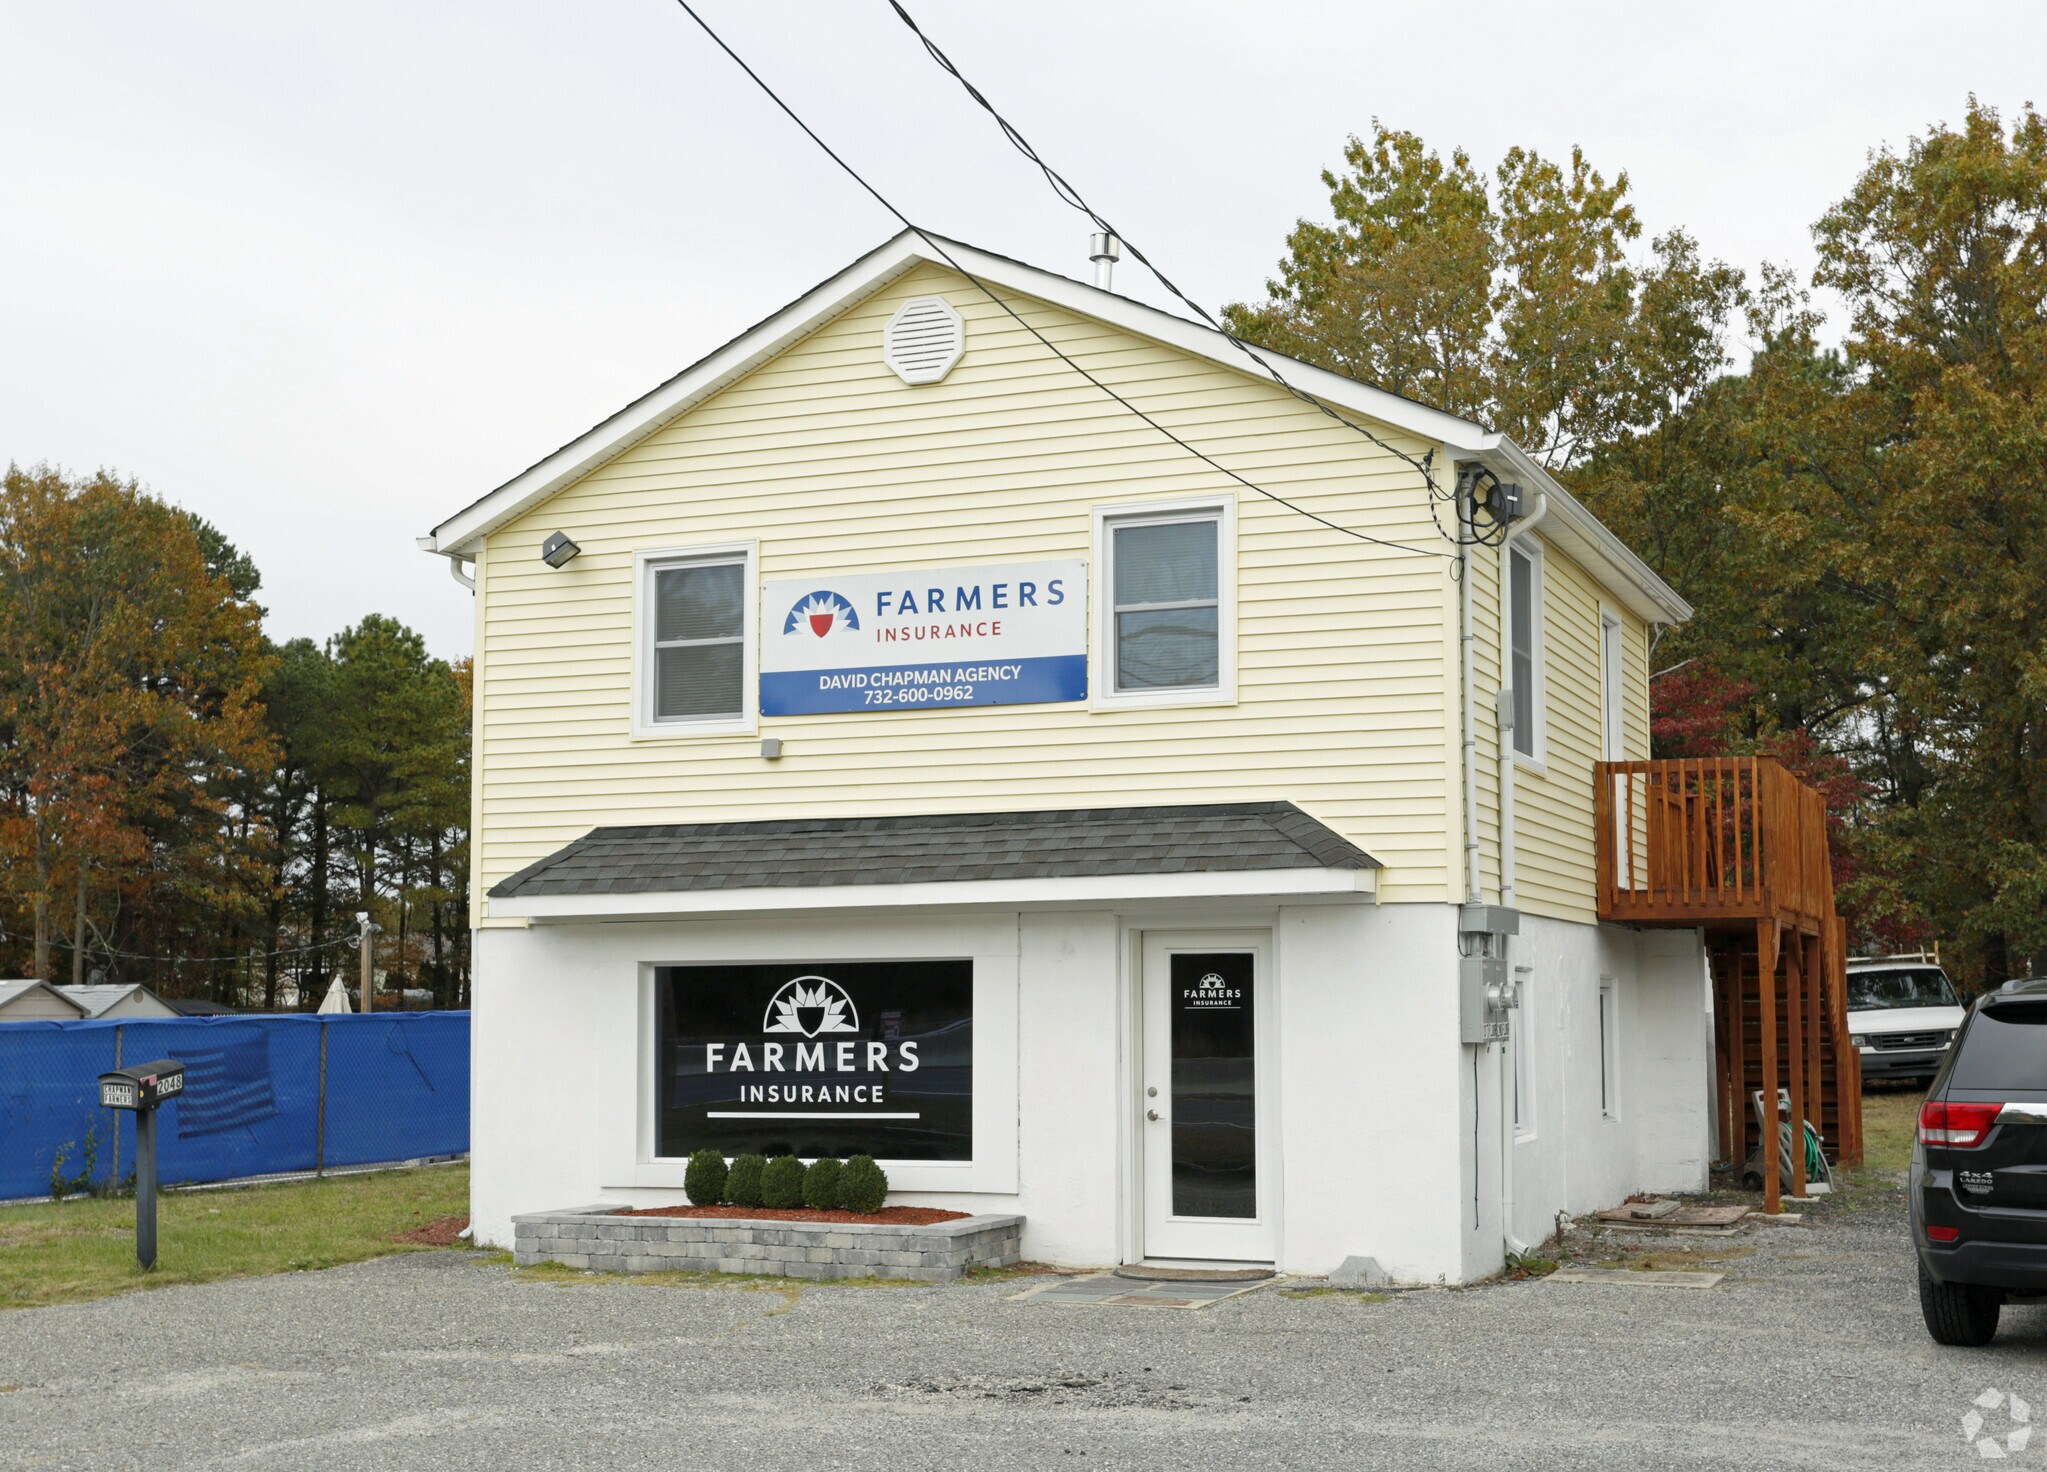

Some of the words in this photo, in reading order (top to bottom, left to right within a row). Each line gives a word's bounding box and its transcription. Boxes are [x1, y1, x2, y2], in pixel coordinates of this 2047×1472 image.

[877, 579, 1065, 617] FARMERS
[877, 621, 1002, 643] INSURANCE
[819, 674, 867, 690] DAVID
[870, 669, 951, 687] CHAPMAN
[954, 665, 1022, 683] AGENCY
[864, 686, 974, 705] 732-600-0962
[1184, 989, 1241, 998] FARMERS
[706, 1041, 920, 1072] FARMERS
[104, 1085, 131, 1094] CHAPMAN
[157, 1075, 182, 1094] 2048
[740, 1085, 883, 1103] INSURANCE
[104, 1095, 132, 1104] FARMERS
